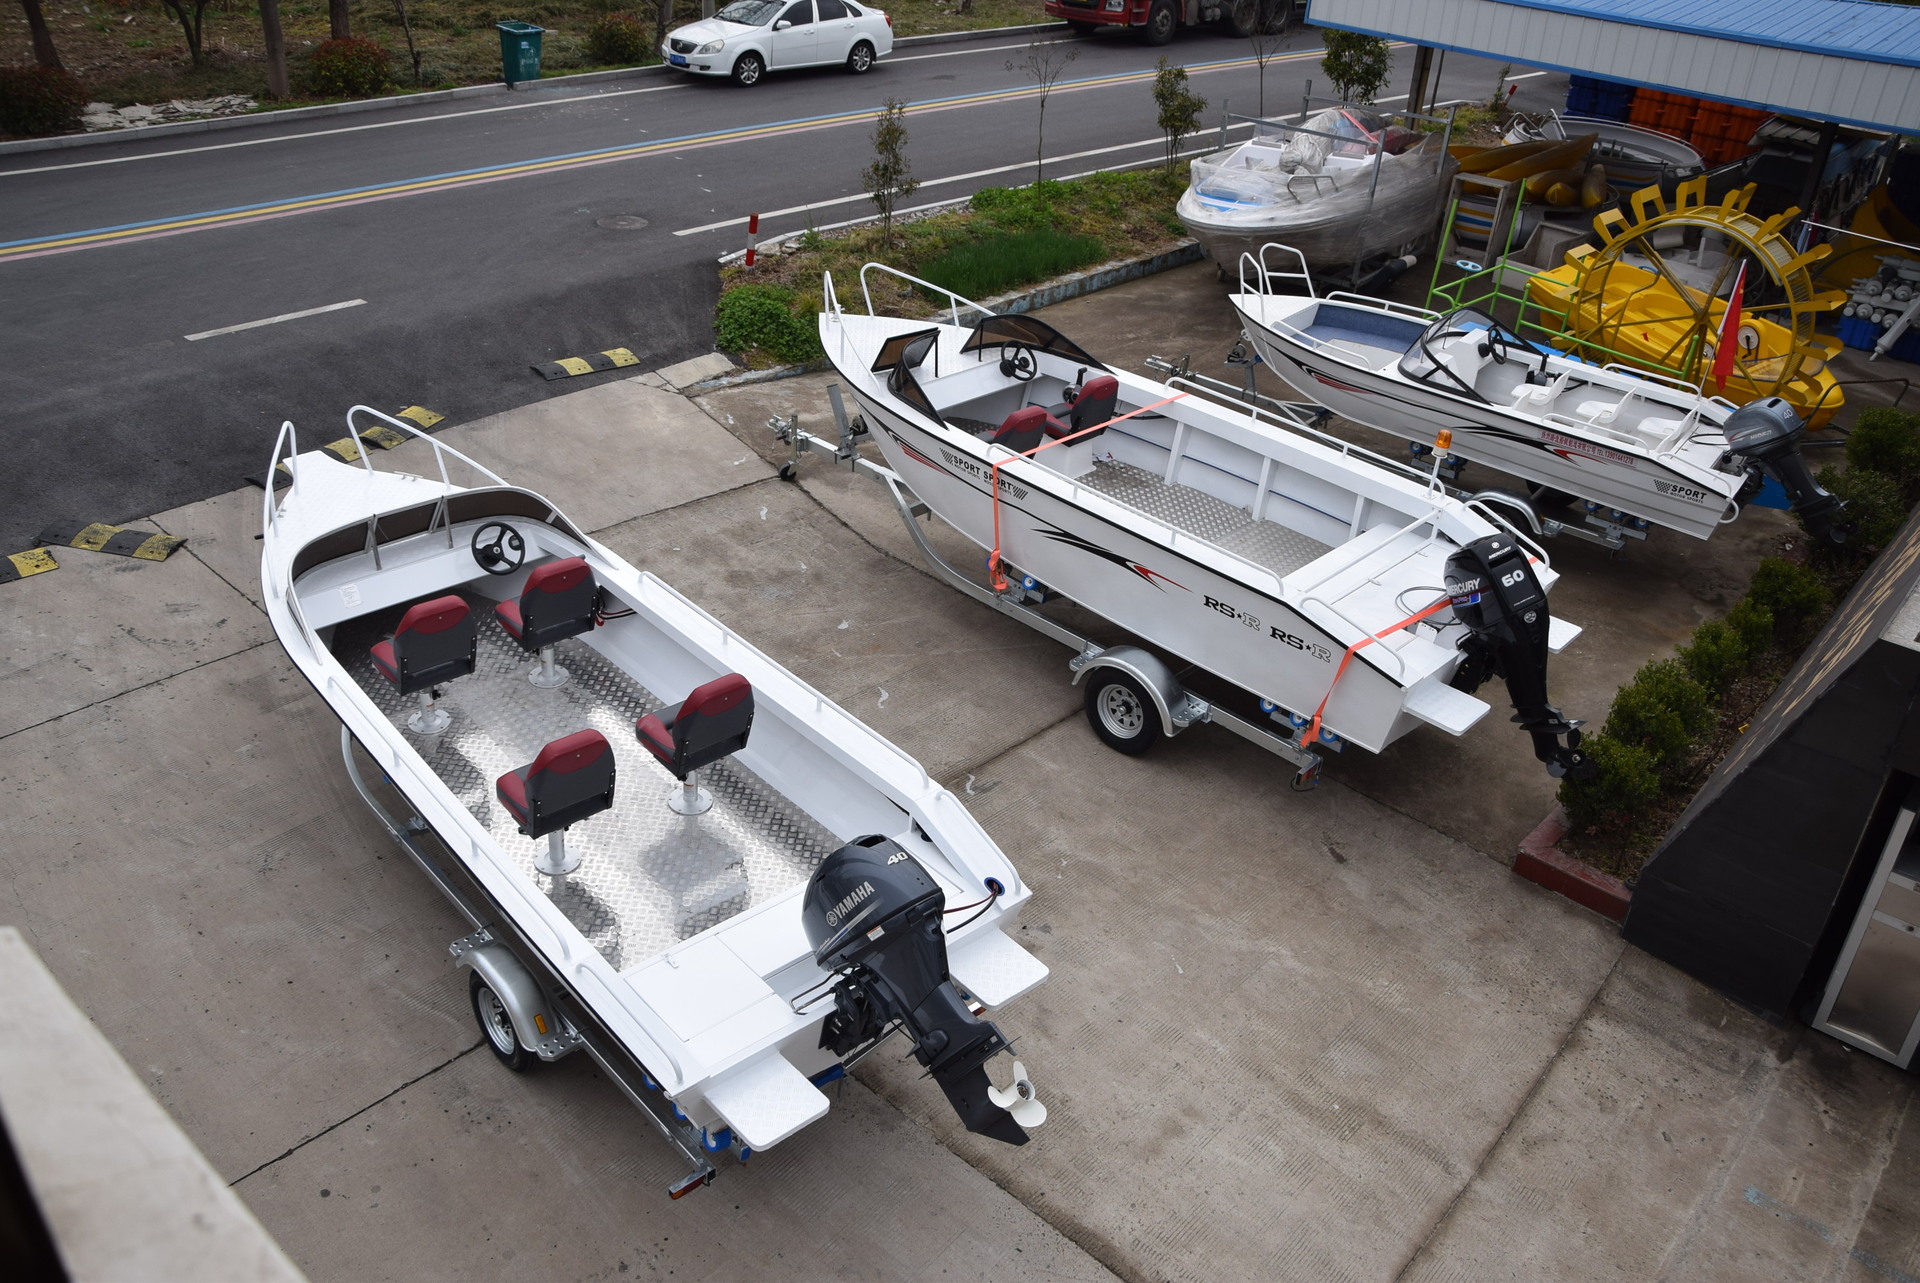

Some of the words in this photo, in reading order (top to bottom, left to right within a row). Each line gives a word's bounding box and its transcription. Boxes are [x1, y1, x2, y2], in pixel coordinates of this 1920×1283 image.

[1783, 408, 1793, 419] 40
[953, 455, 980, 475] SPORT
[1671, 484, 1707, 500] SPORT
[1687, 496, 1704, 504] SPORTS
[1488, 546, 1512, 559] MERCURY
[1502, 570, 1525, 588] 60
[887, 851, 909, 866] 40
[833, 880, 875, 919] YAMAHA
